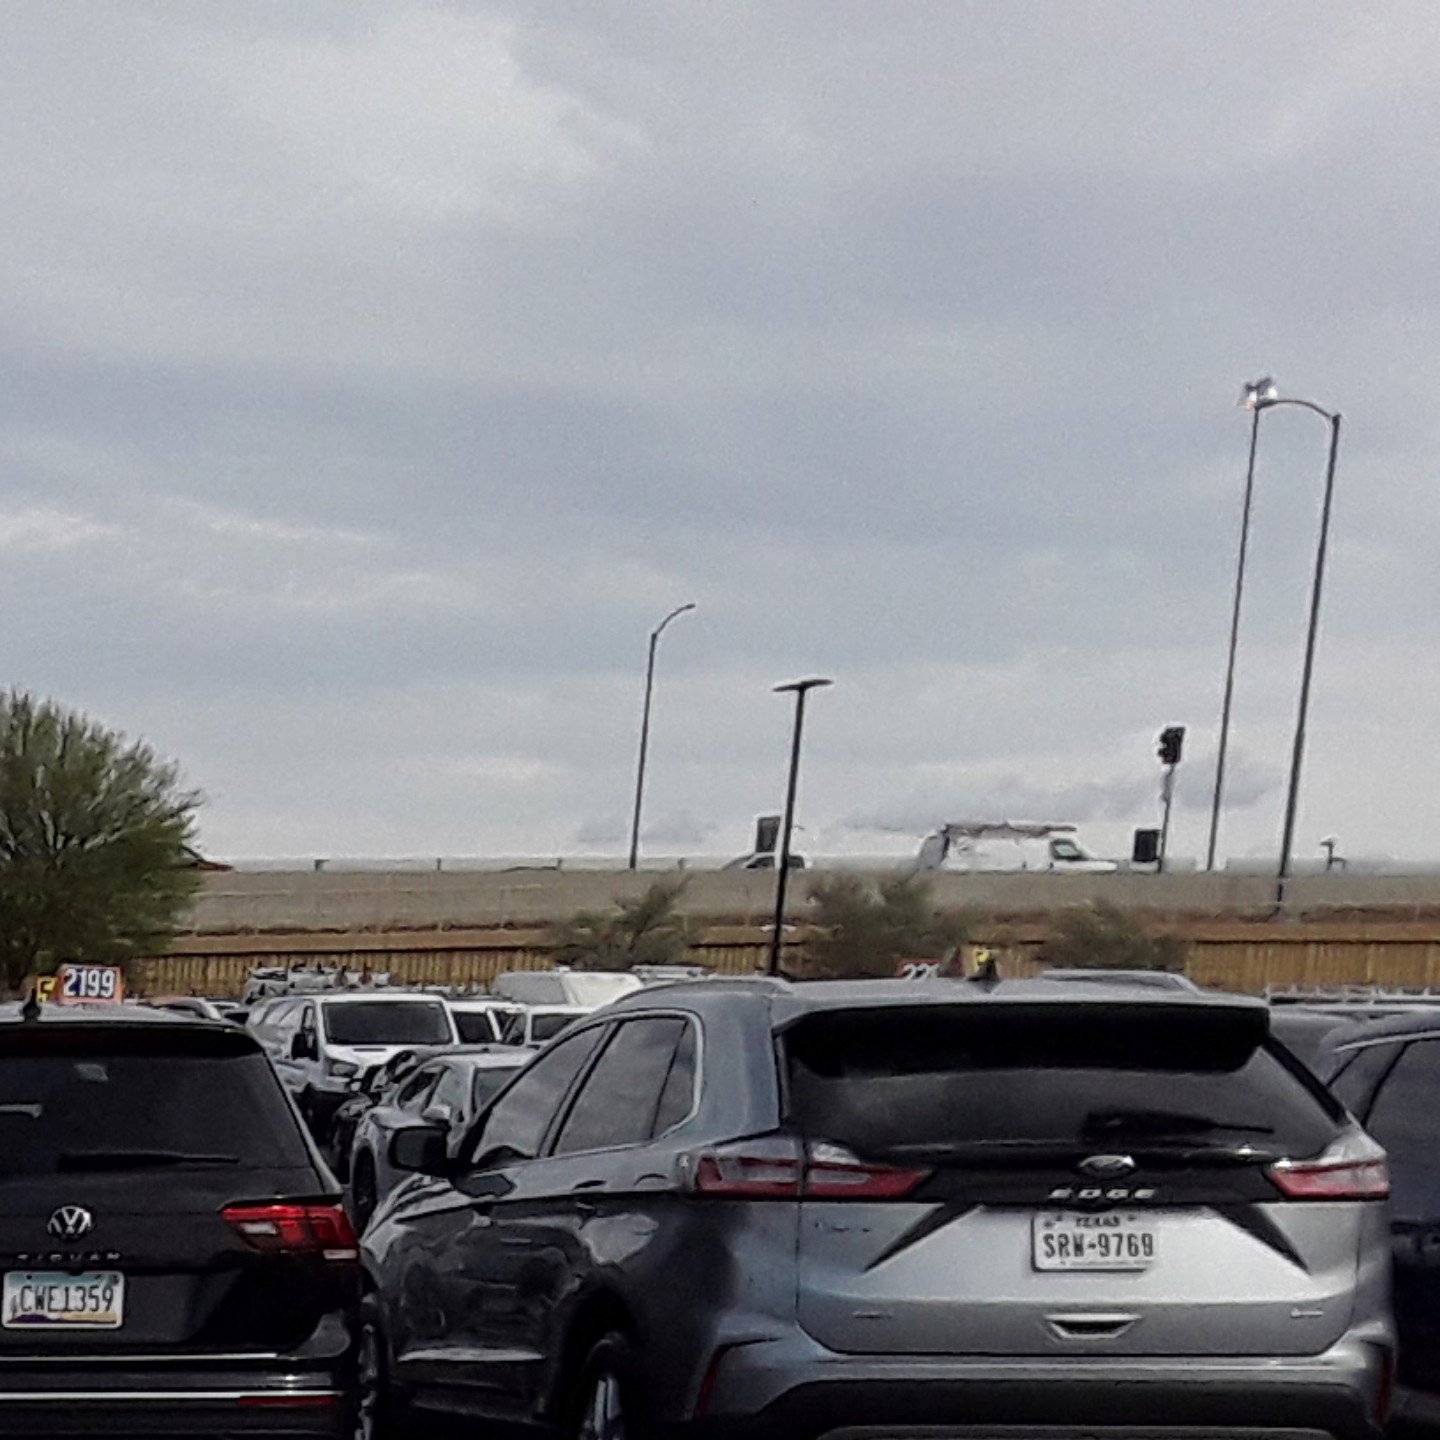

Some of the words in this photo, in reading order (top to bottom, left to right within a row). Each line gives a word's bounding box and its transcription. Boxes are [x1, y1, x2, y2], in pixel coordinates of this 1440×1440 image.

[63, 968, 115, 998] 2199
[1048, 1187, 1156, 1200] EDGE
[1042, 1232, 1154, 1259] SRW-9769
[20, 1285, 114, 1313] CWE1359
